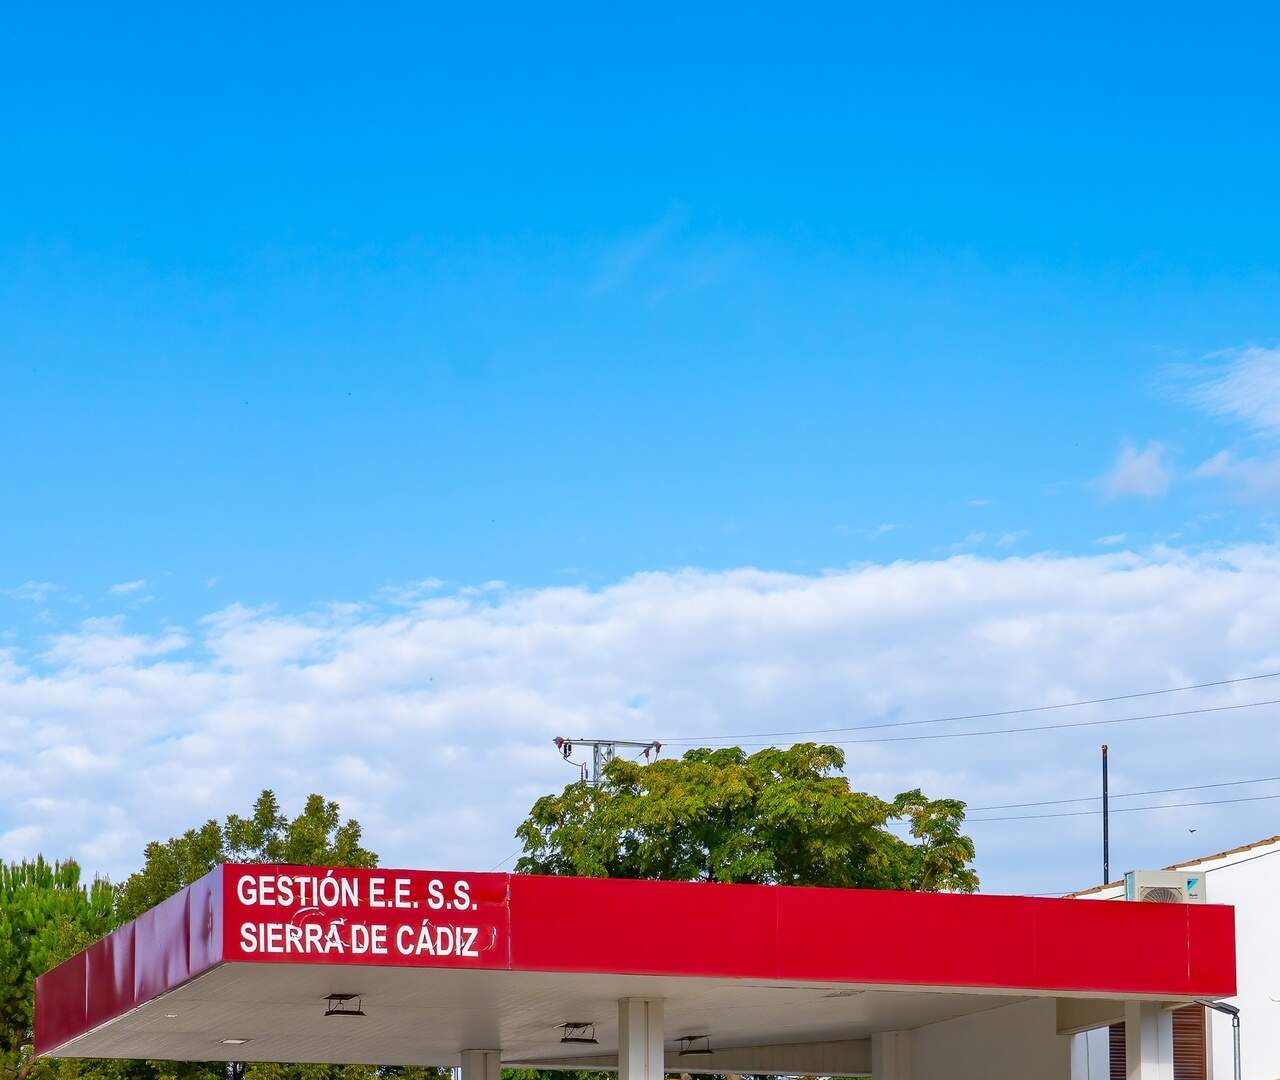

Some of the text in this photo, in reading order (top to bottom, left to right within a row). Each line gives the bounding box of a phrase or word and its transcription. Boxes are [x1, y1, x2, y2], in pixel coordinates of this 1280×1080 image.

[237, 869, 479, 911] GESTIÓN E.E. S.S.
[240, 918, 480, 957] SIERRA DE CÁDIZ
